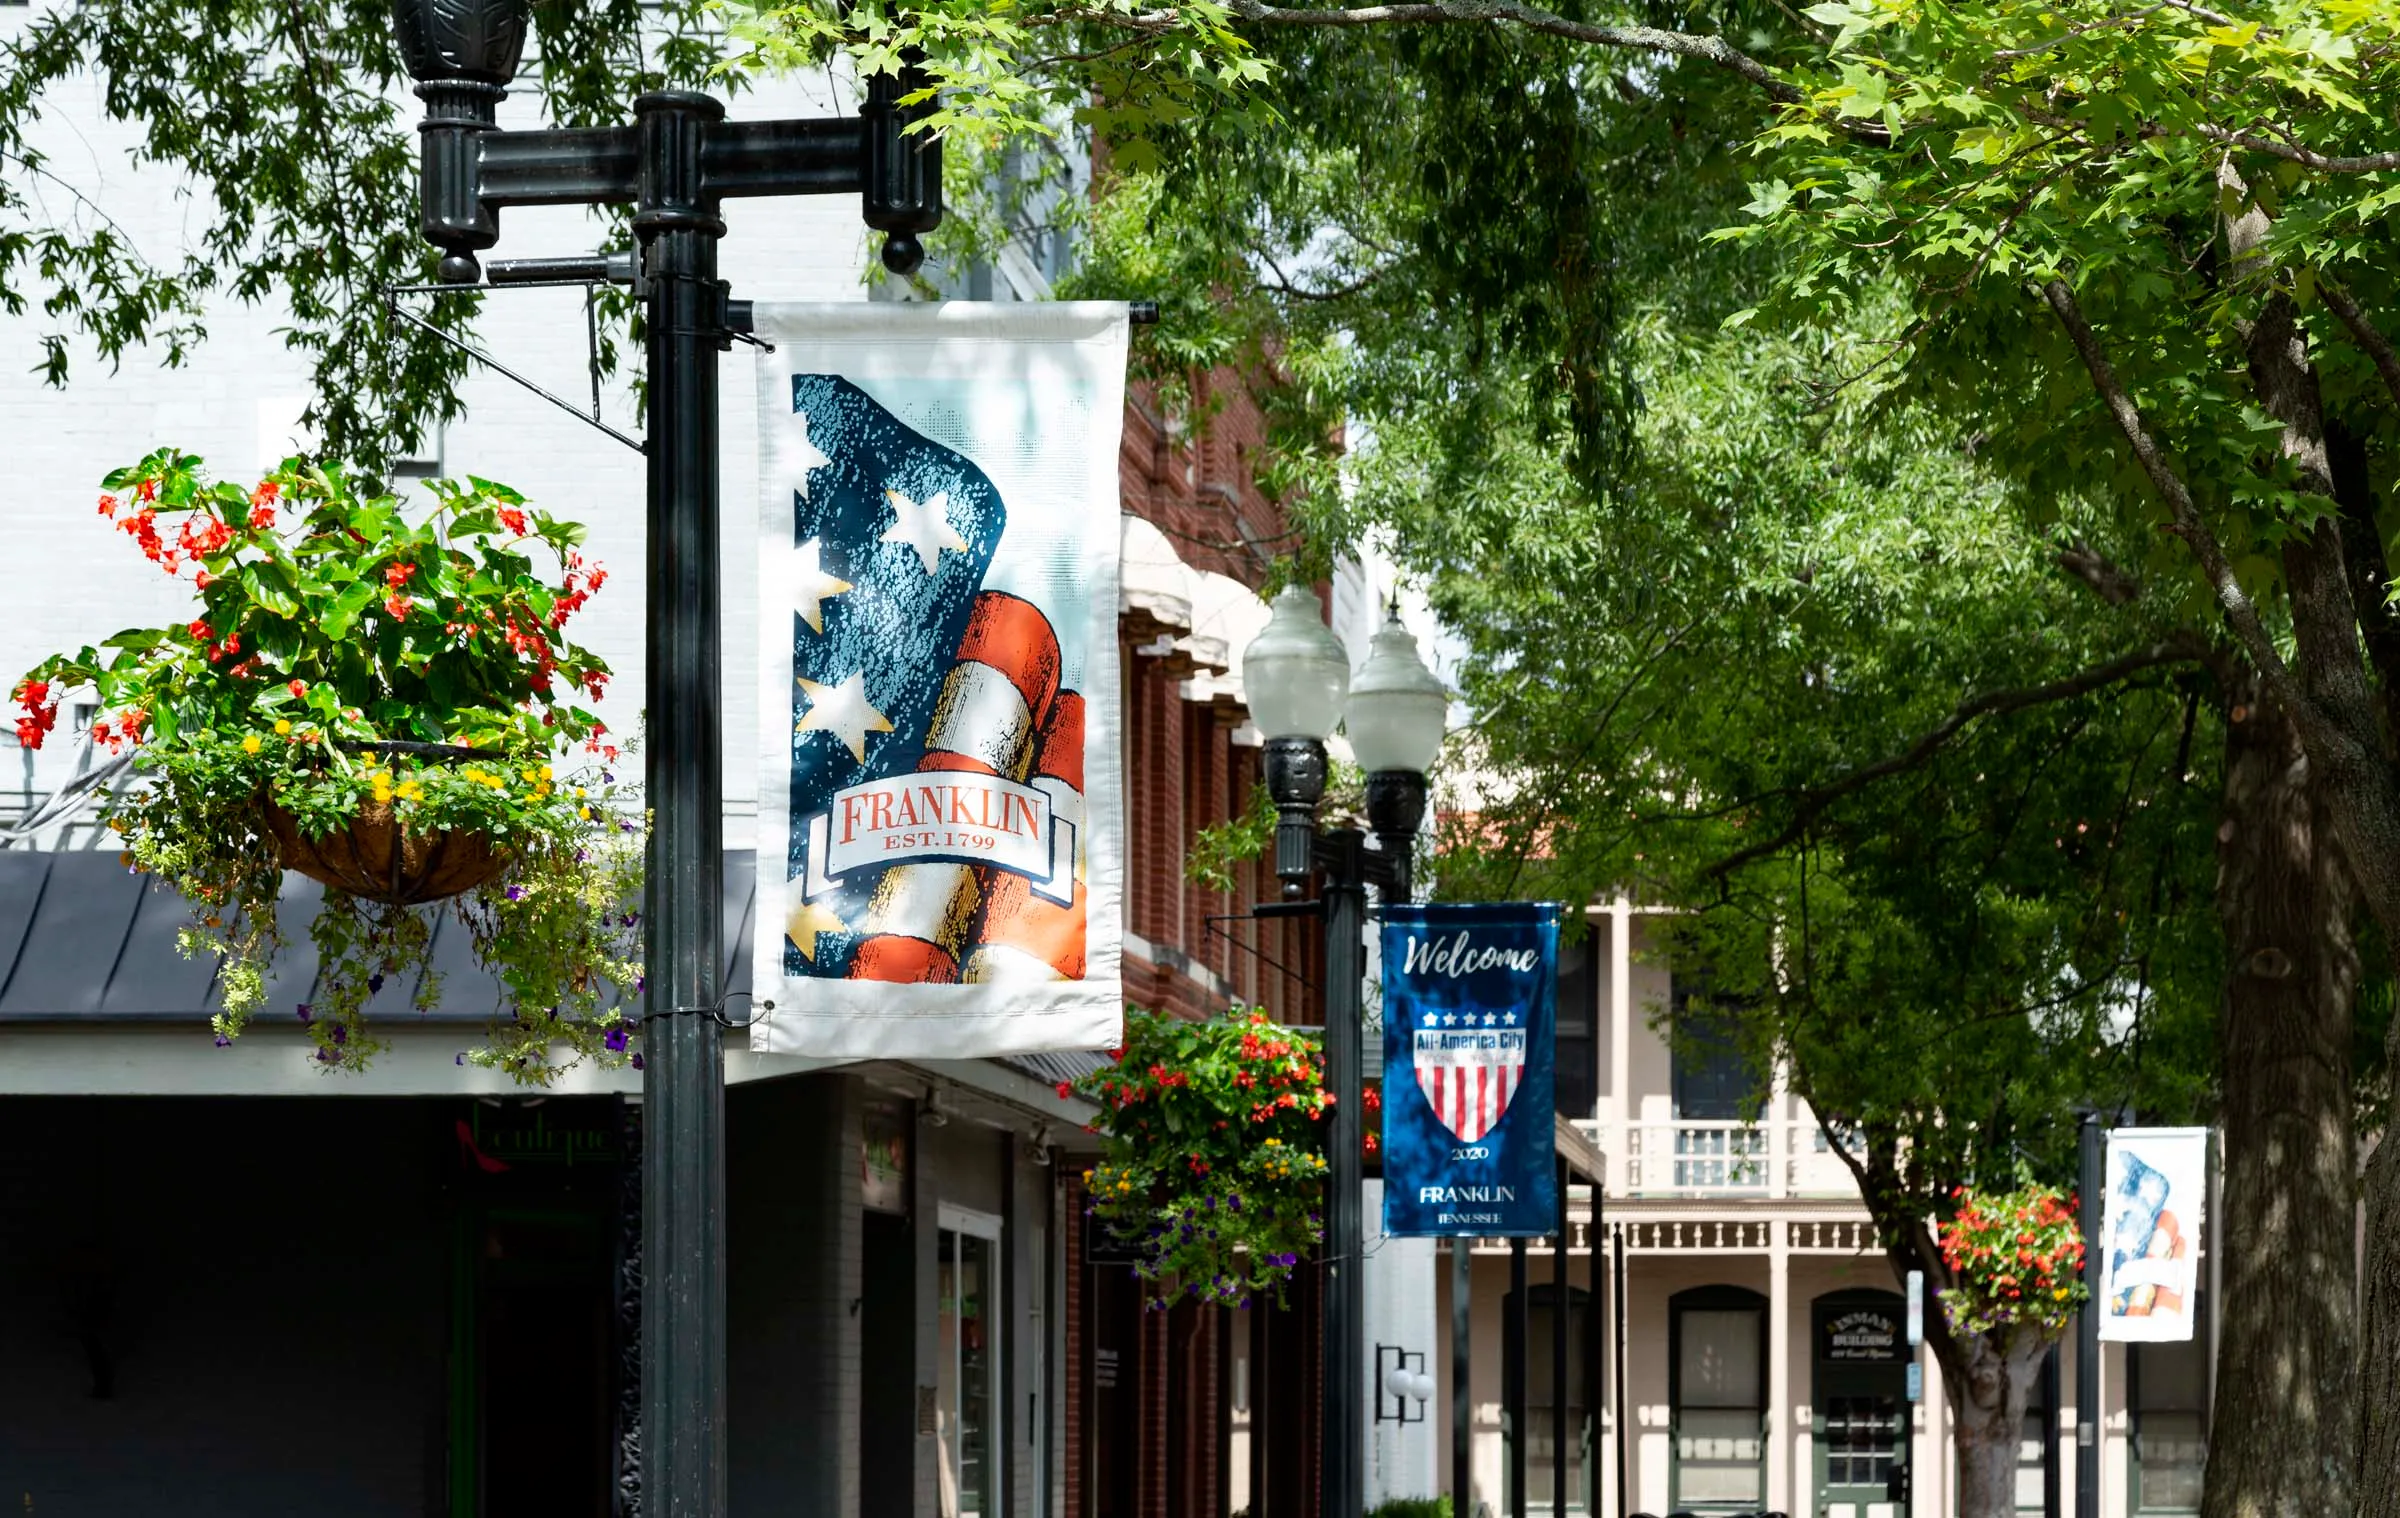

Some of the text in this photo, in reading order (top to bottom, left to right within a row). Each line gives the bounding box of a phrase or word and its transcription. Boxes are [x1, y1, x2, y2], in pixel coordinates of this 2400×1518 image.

[839, 785, 1042, 844] FRANKLIN
[1403, 930, 1540, 978] Welcome
[1417, 1032, 1524, 1050] All-America City
[1451, 1147, 1489, 1160] 2020
[1419, 1186, 1515, 1203] FRANKLIN
[1438, 1212, 1502, 1224] TENNESSEE
